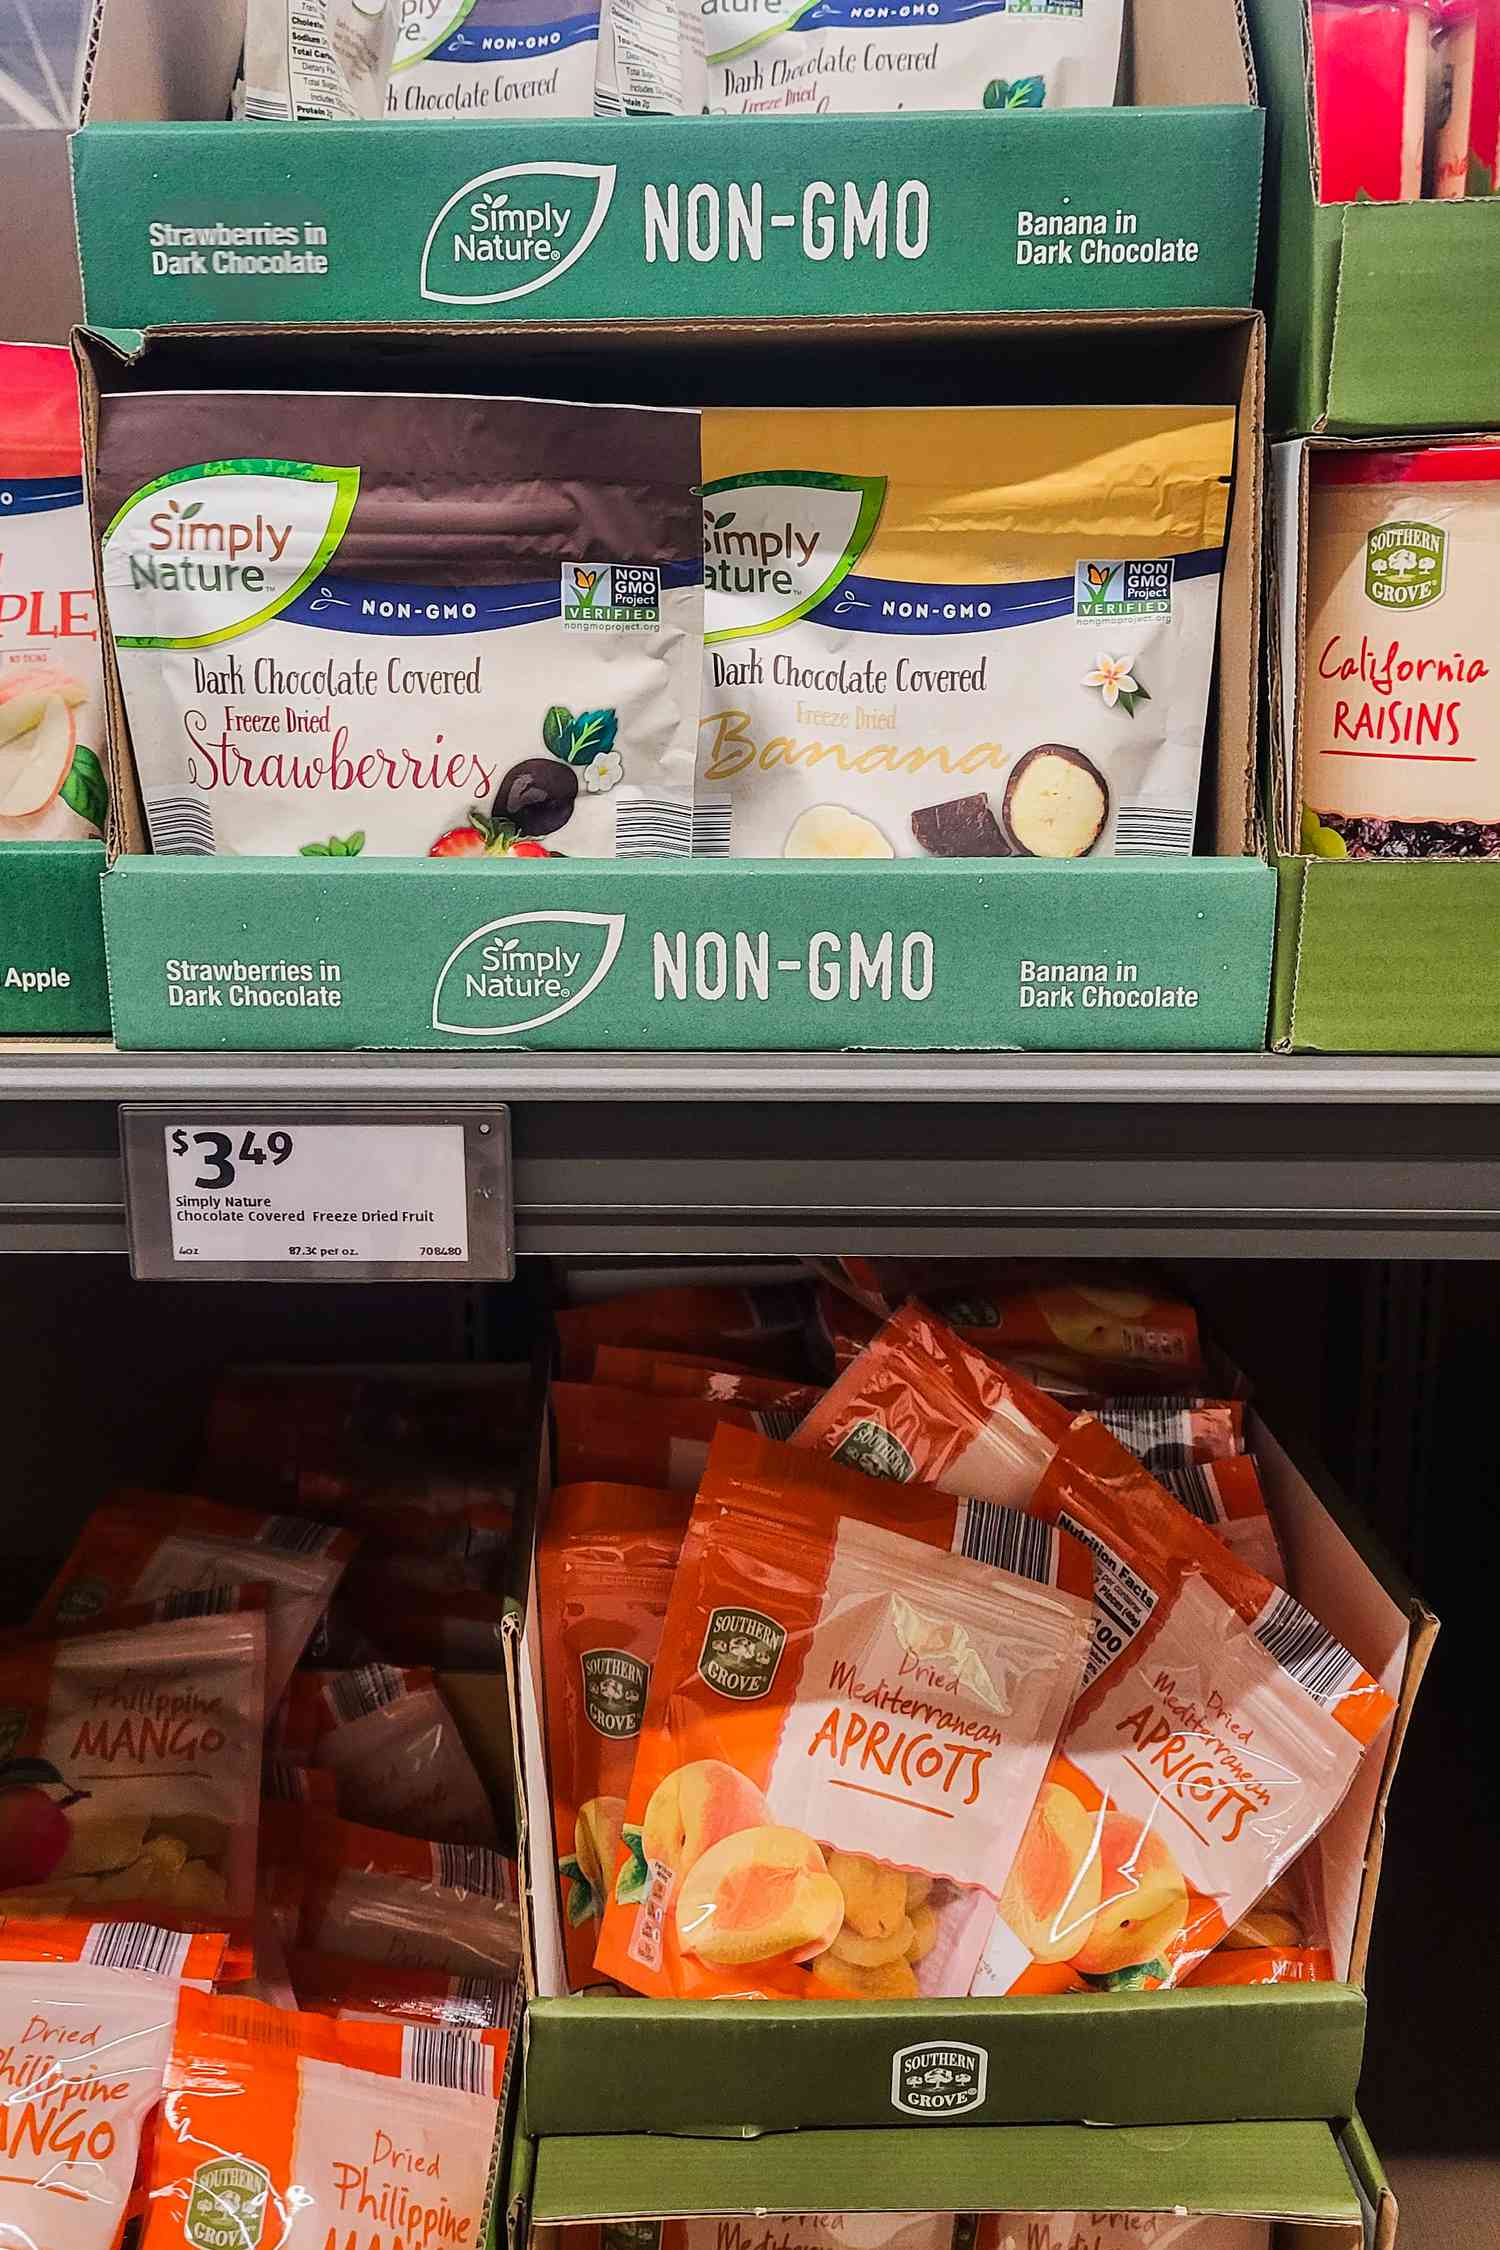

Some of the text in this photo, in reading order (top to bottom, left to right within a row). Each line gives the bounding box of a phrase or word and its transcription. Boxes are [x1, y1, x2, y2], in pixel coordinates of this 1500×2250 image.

[850, 3, 940, 18] NON-GMO
[482, 32, 561, 50] NON-GMO
[724, 43, 939, 96] Dark Chocolate Covered
[405, 81, 489, 111] Chocolate
[494, 67, 560, 103] Covered
[786, 81, 817, 107] Dried
[470, 202, 571, 238] Simply
[643, 178, 930, 263] NON-GMO
[1017, 210, 1137, 236] Banana in
[149, 221, 327, 247] Strawberries in
[152, 250, 328, 275] Dark Chocolate
[1016, 238, 1199, 265] Dark Chocolate
[149, 512, 294, 562] Simply
[1369, 527, 1441, 554] SOUTHERN
[129, 554, 265, 593] Nature
[615, 568, 654, 581] NON
[1127, 575, 1168, 588] GMO
[1128, 563, 1168, 574] NON
[614, 581, 656, 594] GMO
[615, 594, 655, 606] Project
[1127, 588, 1168, 600] Project
[1372, 580, 1432, 603] GROVE
[361, 598, 478, 621] NON-GMO
[569, 607, 656, 620] VERIFIED
[881, 600, 993, 619] NON-GMO
[1081, 601, 1168, 615] VERIFIED
[564, 621, 660, 632] nongmoproject.org
[193, 654, 482, 696] Dark Chocolate Covered
[712, 648, 987, 694] Dark Chocolate Covered
[1318, 635, 1489, 695] California
[223, 705, 331, 733] Freeze Dried
[796, 701, 897, 730] Freeze Dried
[1333, 700, 1462, 746] RAISINS
[184, 709, 497, 798] Strawberries
[699, 709, 1009, 780] Banana
[165, 960, 342, 983] Strawberries in
[482, 946, 581, 977] Simply
[652, 931, 934, 1001] NON-GMO
[1019, 961, 1137, 983] Banana in
[4, 967, 71, 992] Apple
[167, 985, 342, 1008] Dark Chocolate
[1019, 985, 1199, 1008] Dark Chocolate
[175, 1196, 272, 1210] Simply Nature
[176, 1210, 435, 1223] Chocolate Covered Freeze Dried Fruit
[178, 1246, 200, 1256] 4oz
[320, 1247, 338, 1258] per
[419, 1246, 462, 1256] 708480
[1059, 1513, 1155, 1606] Nutrition Facts
[713, 1616, 780, 1651] SOUTHERN
[586, 1658, 644, 1686] SOUTHERN
[707, 1660, 762, 1691] GROVE
[899, 1647, 960, 1695] Dried
[589, 1703, 637, 1730] GROVE
[829, 1660, 1001, 1746] Mediterranean
[1207, 1690, 1254, 1744] Dried
[70, 1718, 226, 1764] MANGO
[807, 1707, 993, 1805] APRICOTS
[1115, 1705, 1258, 1842] APRICOTS
[21, 2015, 102, 2046] Dried
[904, 2052, 975, 2073] SOUTHERN
[0, 2046, 130, 2112] hilippine
[907, 2090, 968, 2107] GROVE
[0, 2102, 115, 2170] NGO
[372, 2129, 440, 2178] Dried
[199, 2167, 262, 2192] SOUTHERN
[332, 2161, 472, 2244] Philippine
